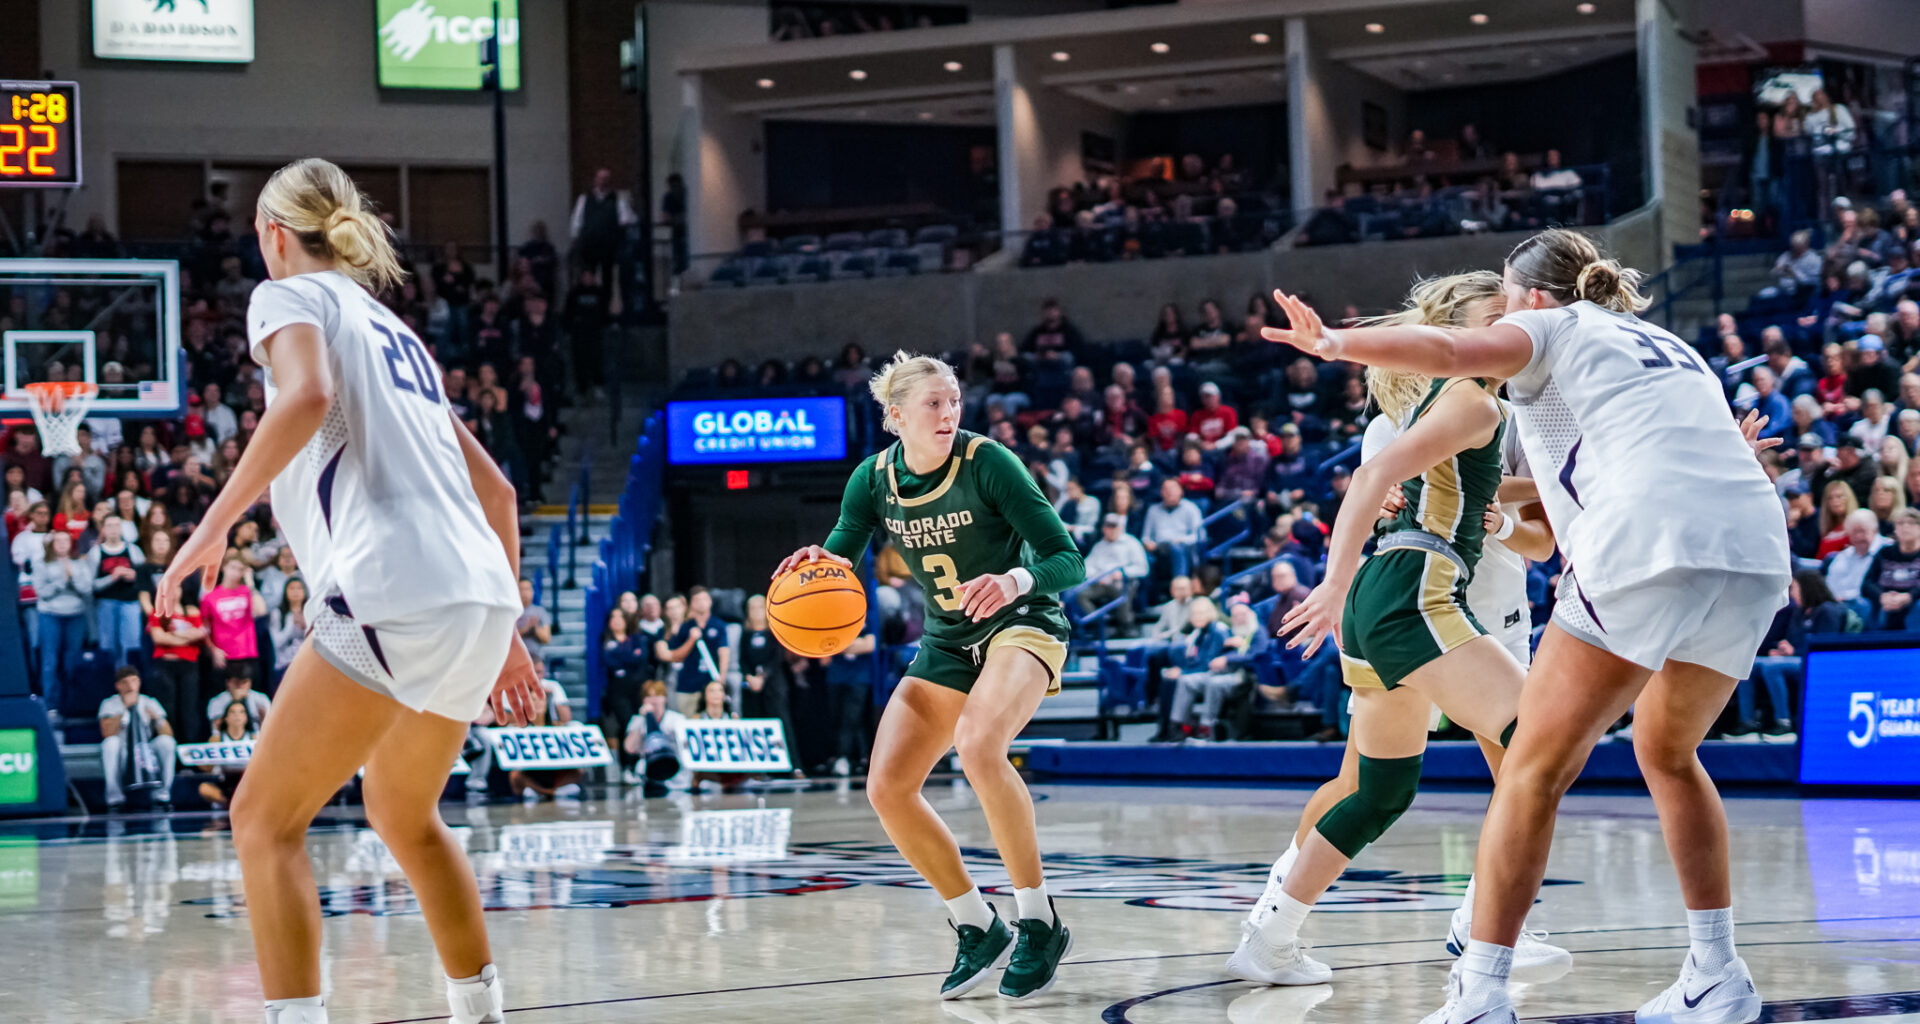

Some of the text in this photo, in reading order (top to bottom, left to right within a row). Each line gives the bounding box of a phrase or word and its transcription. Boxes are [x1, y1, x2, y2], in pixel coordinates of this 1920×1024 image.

[12, 93, 67, 124] 1:28
[0, 124, 57, 175] 22
[368, 318, 441, 405] 20
[1616, 324, 1706, 375] 33
[693, 408, 816, 436] GLOBAL
[694, 435, 816, 452] CREDIT UNION
[885, 510, 973, 535] COLORADO
[902, 529, 956, 549] STATE
[799, 567, 848, 585] NCAA
[922, 553, 965, 611] 3
[1847, 692, 1875, 748] 5
[1881, 698, 1914, 717] YEAR
[501, 732, 600, 761] DEFENSE
[685, 727, 780, 762] DEFENSE
